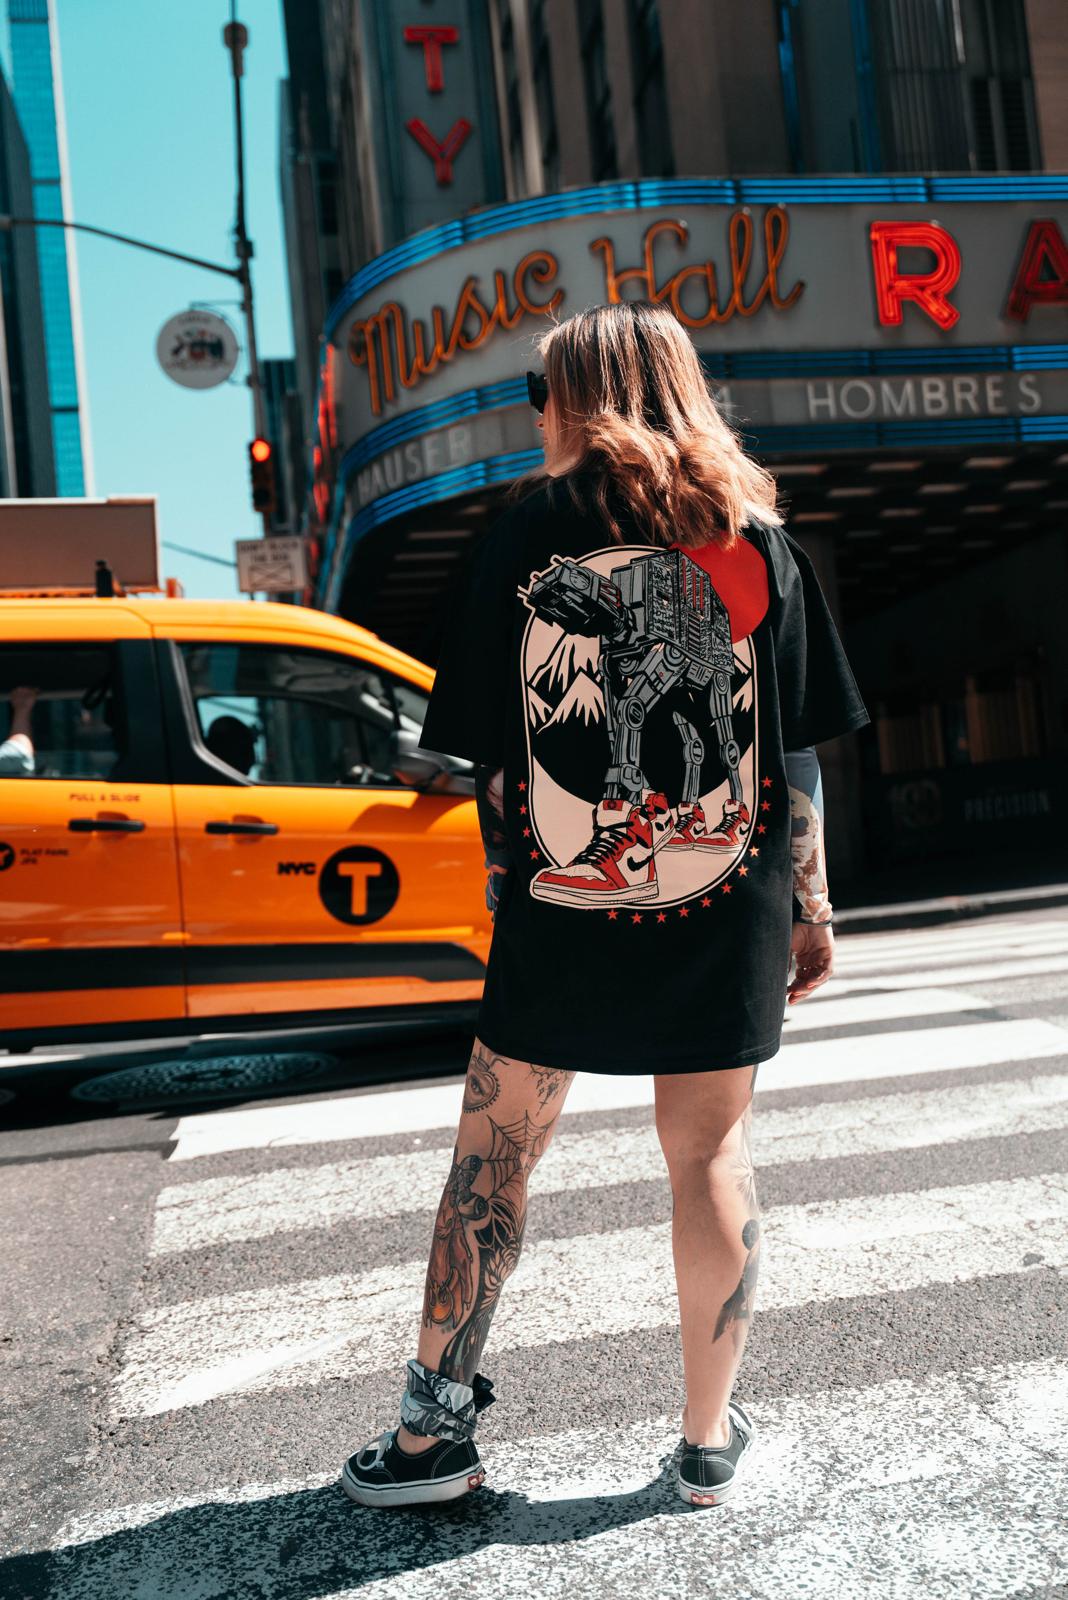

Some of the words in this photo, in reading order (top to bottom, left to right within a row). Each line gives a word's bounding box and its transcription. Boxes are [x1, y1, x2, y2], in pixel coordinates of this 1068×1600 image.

[350, 252, 564, 413] Music
[590, 205, 807, 327] Hall
[807, 374, 1041, 418] HOMBRES
[277, 862, 317, 876] NYC
[337, 862, 382, 917] T
